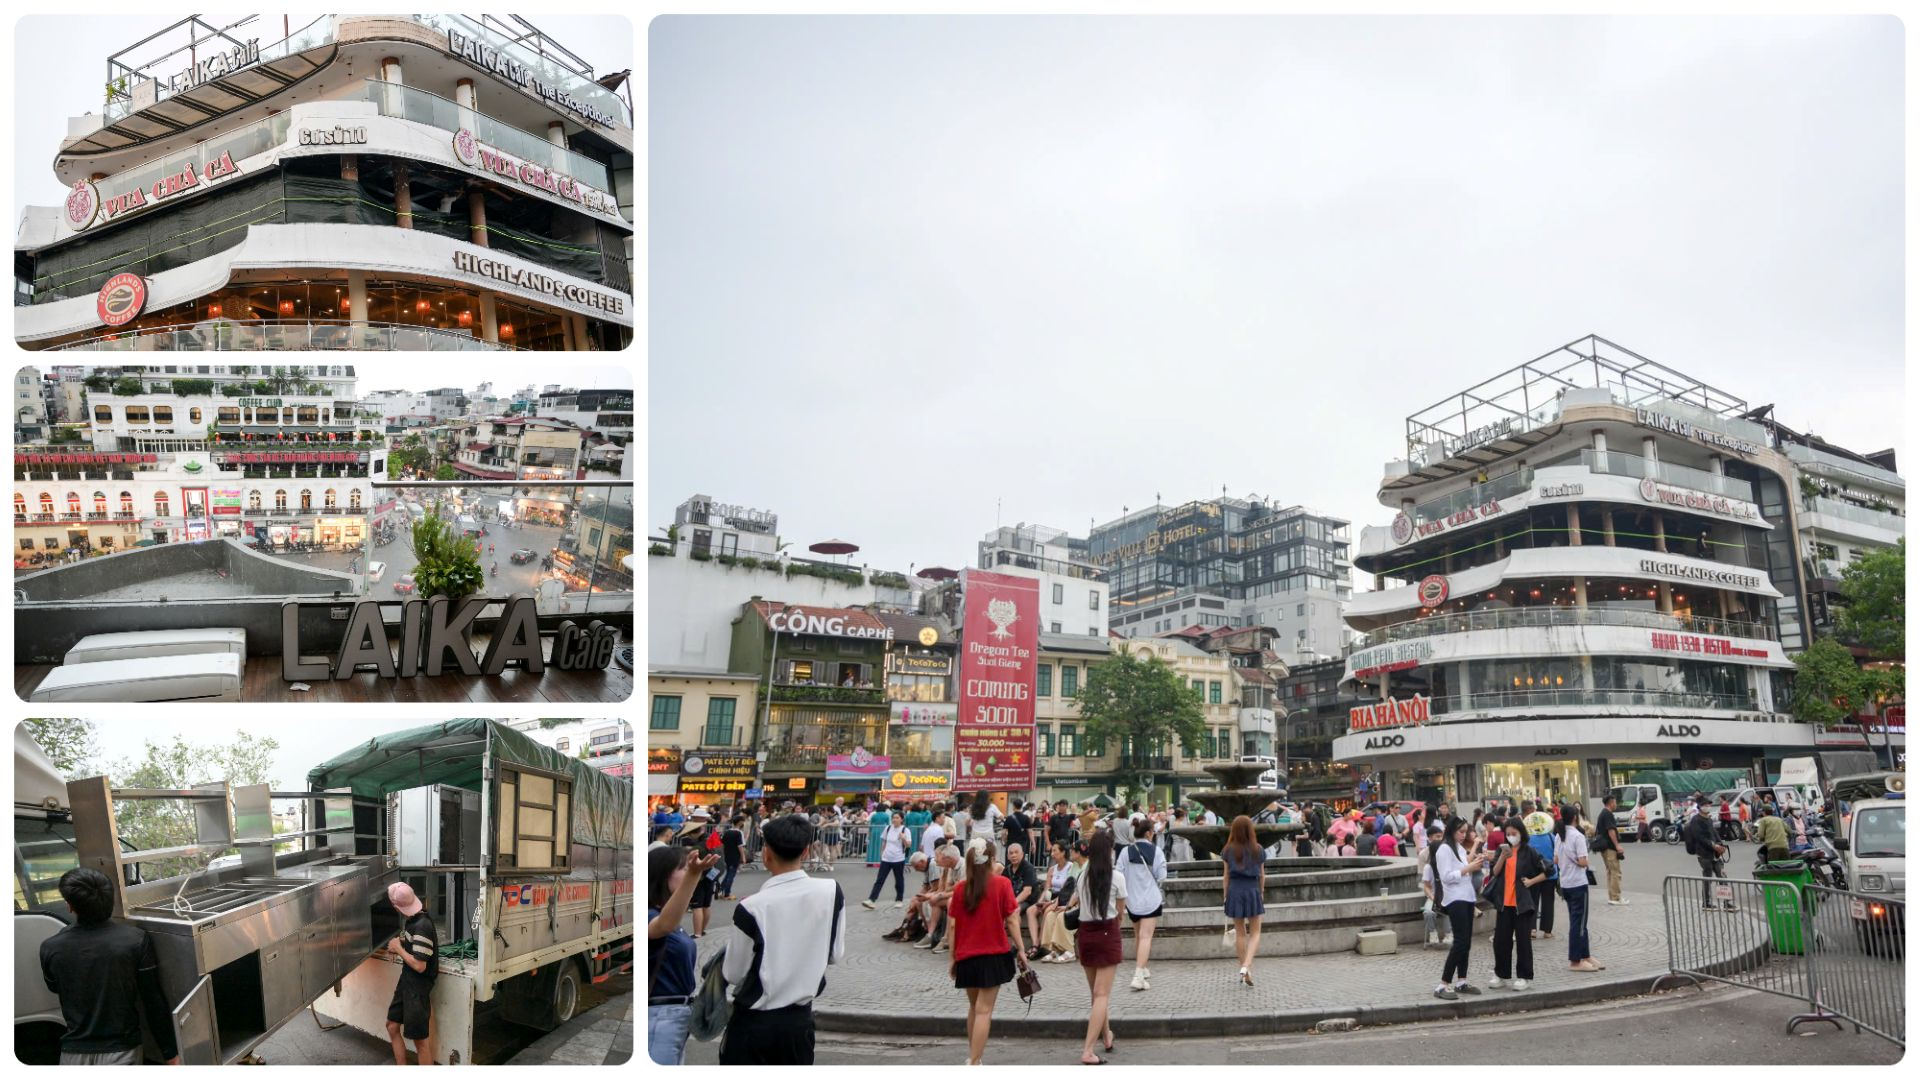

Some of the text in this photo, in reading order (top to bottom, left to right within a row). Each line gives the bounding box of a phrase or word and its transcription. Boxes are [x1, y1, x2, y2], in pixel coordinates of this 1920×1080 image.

[168, 37, 260, 94] LAIKA Café
[448, 28, 507, 76] LAIKA
[533, 79, 556, 101] The
[557, 89, 616, 130] Exceptional
[479, 149, 518, 180] VUA
[104, 150, 239, 217] VUA CHẢ CÁ
[100, 276, 141, 303] HIGHLANDS
[455, 251, 623, 315] HIGHLANDS COFFEE
[104, 305, 137, 323] COFFEE
[1636, 408, 1679, 433] LAIKA
[1696, 430, 1713, 443] The
[1714, 434, 1760, 456] Exceptional
[1163, 526, 1197, 545] HOTEL
[1641, 560, 1760, 587] HIGHLANDS COFFEE
[281, 596, 615, 681] LAIKA Café
[970, 642, 1030, 658] Dragon Tea
[967, 679, 1028, 700] COMING
[1351, 693, 1431, 731] BIA HÀ NỘI
[1365, 735, 1405, 750] ALDO
[1656, 724, 1701, 737] ALDO
[977, 739, 1005, 747] 30.000
[1534, 748, 1568, 756] ALDO
[704, 758, 723, 766] PATE
[682, 783, 706, 791] PATE
